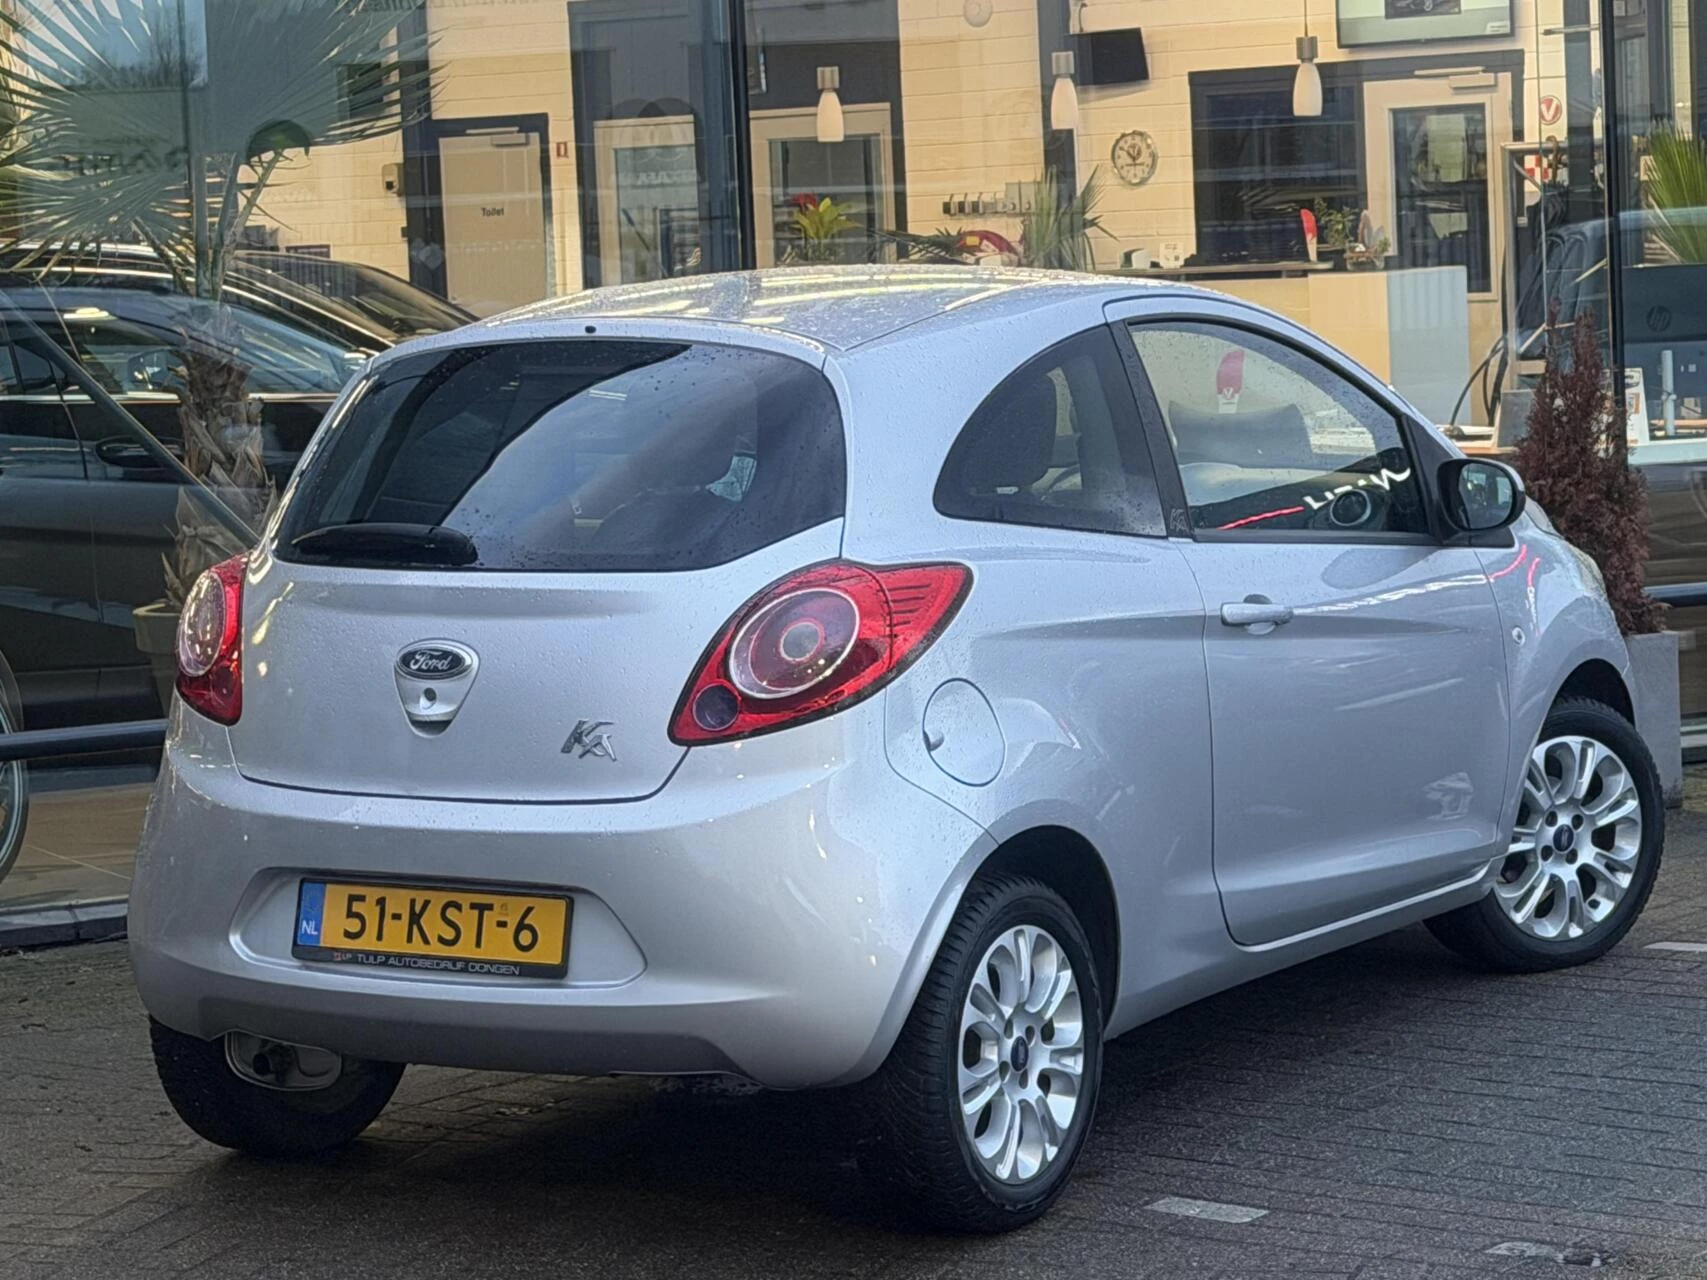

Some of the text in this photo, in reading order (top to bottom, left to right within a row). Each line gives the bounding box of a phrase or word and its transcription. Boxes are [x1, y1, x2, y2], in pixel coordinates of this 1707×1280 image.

[481, 207, 505, 217] Toilet
[410, 650, 453, 670] Ford
[301, 920, 318, 935] NL
[343, 894, 539, 953] 51-KST-6
[357, 953, 386, 965] TULP
[468, 962, 520, 976] DONGEN
